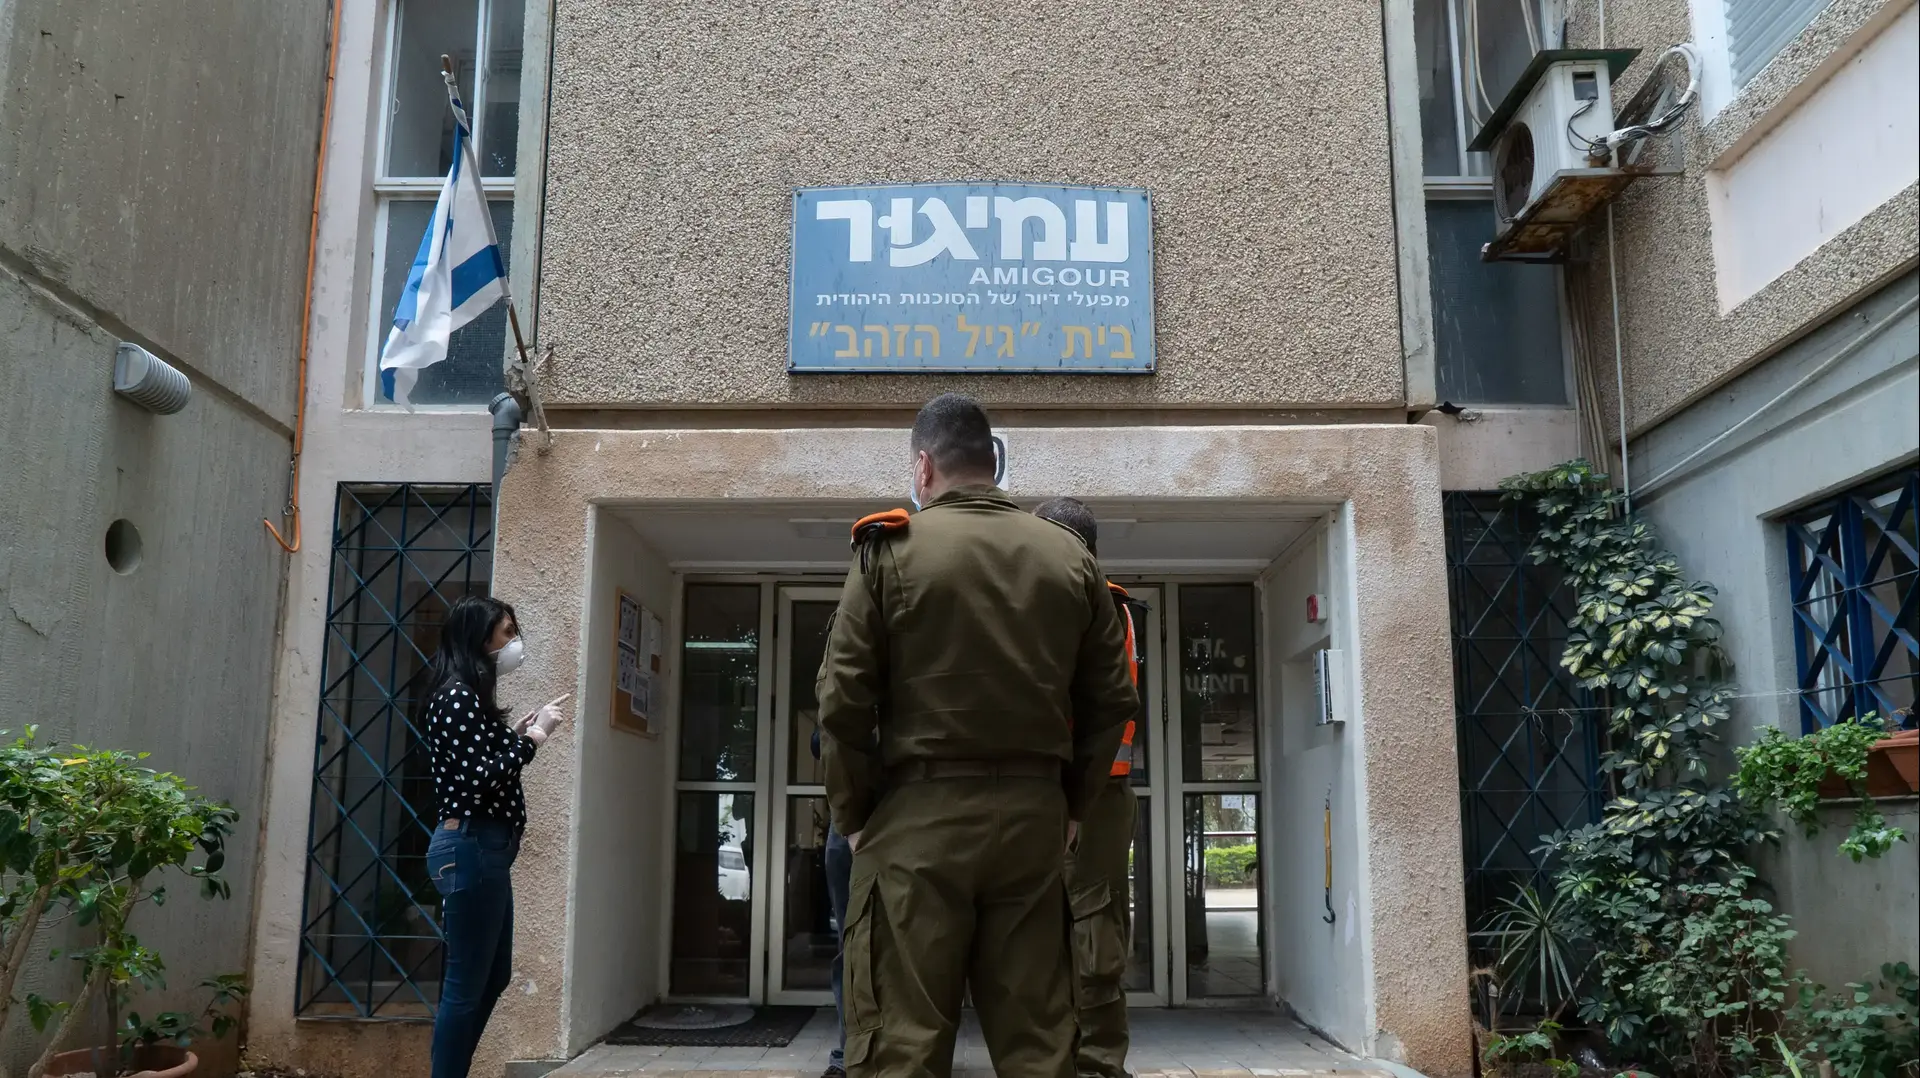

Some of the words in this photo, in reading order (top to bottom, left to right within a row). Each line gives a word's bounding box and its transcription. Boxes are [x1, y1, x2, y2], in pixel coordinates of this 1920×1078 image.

[968, 267, 1130, 288] AMIGOUR
[816, 292, 891, 306] היהודית
[899, 291, 980, 305] הסוכנות
[987, 289, 1017, 306] של
[1025, 292, 1060, 305] דיור
[1067, 290, 1130, 308] מפעלי
[1062, 325, 1136, 359] בית
